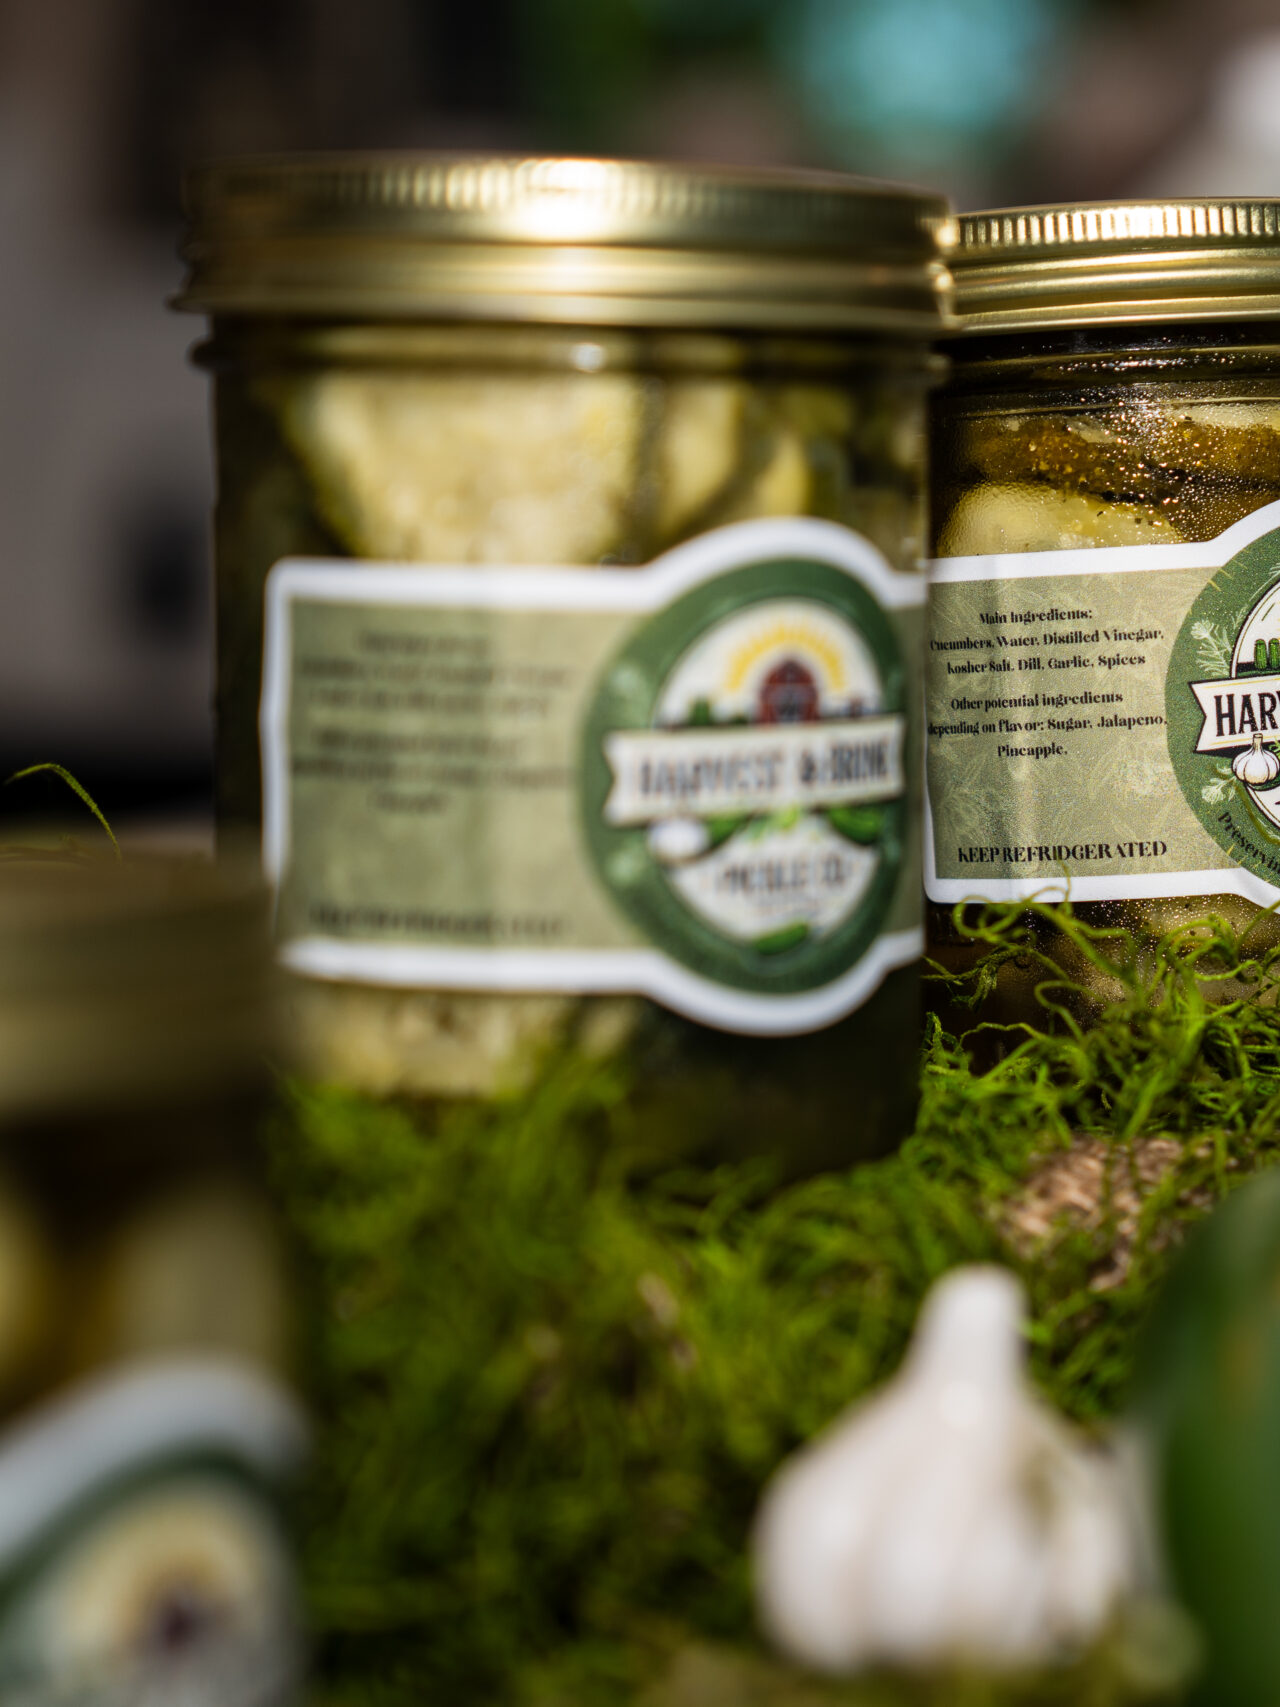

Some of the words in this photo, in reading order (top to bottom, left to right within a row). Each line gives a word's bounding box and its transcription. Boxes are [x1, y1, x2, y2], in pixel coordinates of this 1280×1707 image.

[980, 610, 1007, 625] Main
[1011, 608, 1093, 625] Ingredients:
[930, 637, 995, 651] Cucumbers,
[996, 635, 1040, 648] Water,
[1043, 629, 1100, 645] Distilled
[1102, 628, 1165, 643] Vinegar,
[947, 661, 987, 675] Kosher
[988, 659, 1015, 672] Salt,
[1018, 657, 1045, 671] Dill,
[1047, 655, 1095, 670] Garlic,
[1098, 653, 1146, 670] Spices
[951, 695, 983, 711] Other
[984, 693, 1039, 713] potential
[1042, 691, 1124, 708] ingredients
[928, 720, 979, 739] depending
[982, 723, 996, 734] on
[1047, 717, 1093, 732] Sugar,
[957, 847, 1000, 863] KEEP
[1001, 840, 1168, 863] REFRIDGERATED
